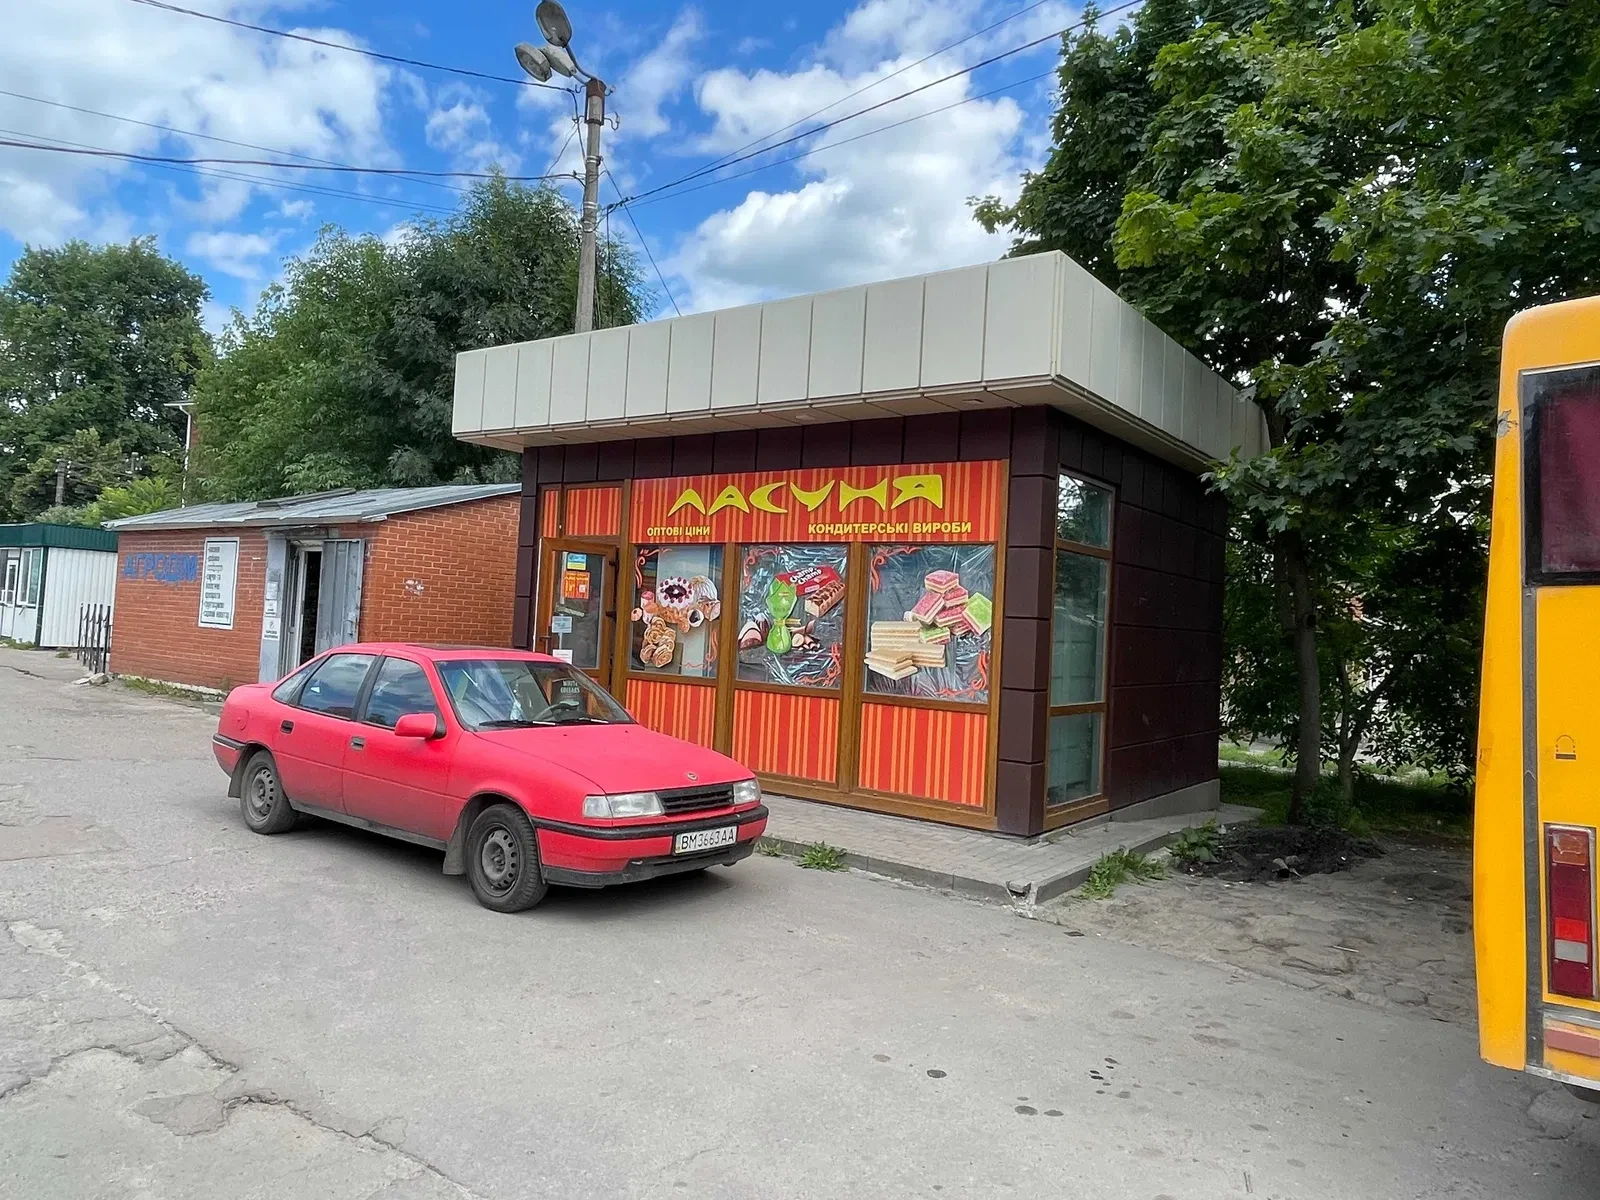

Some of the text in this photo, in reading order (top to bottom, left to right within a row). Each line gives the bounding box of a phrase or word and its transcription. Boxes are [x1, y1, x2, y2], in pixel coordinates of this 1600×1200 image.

[667, 474, 943, 518] ЛАСУНЯ
[647, 526, 711, 538] ОПТОВІ ЦІНИ
[808, 521, 972, 536] КОНДИТЕРСЬКІ ВИРОБИ
